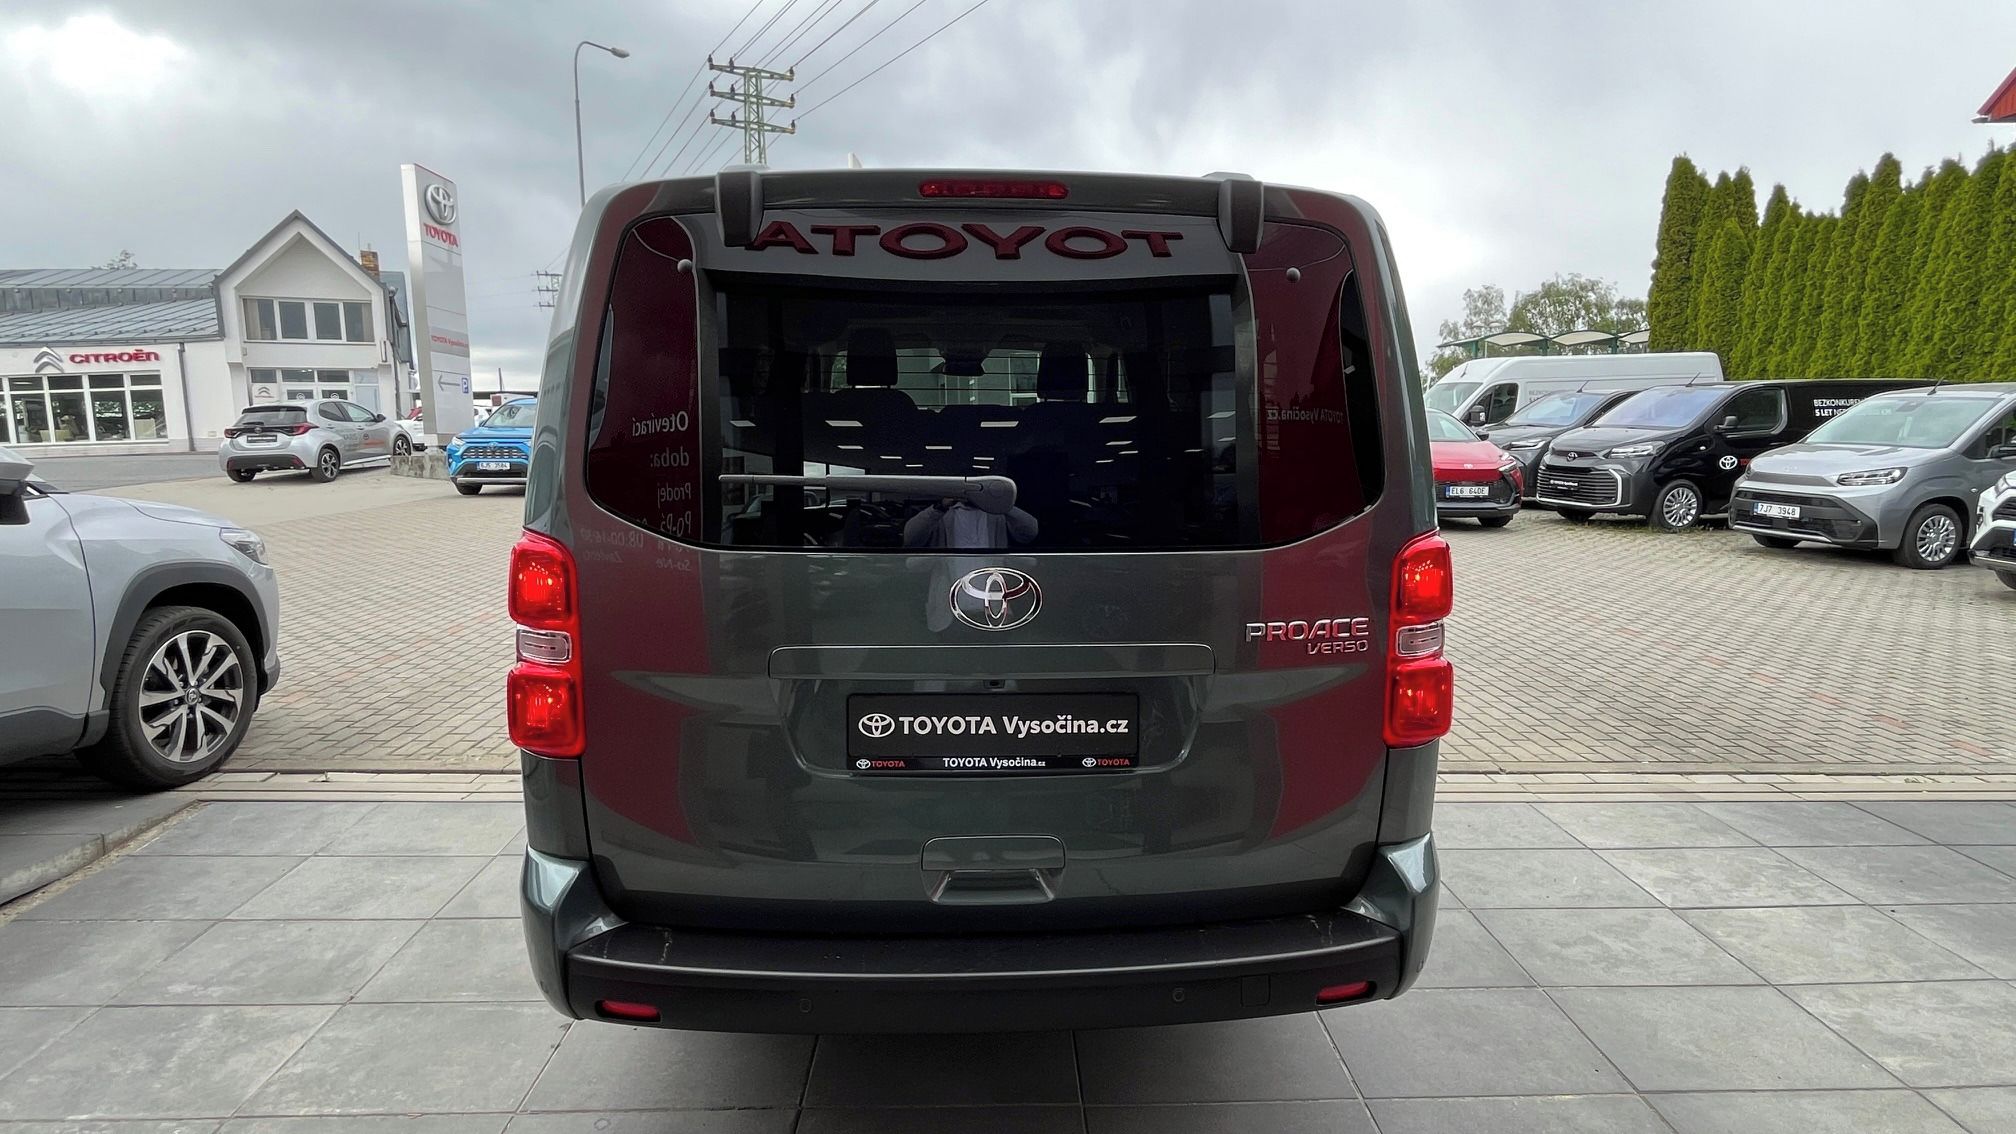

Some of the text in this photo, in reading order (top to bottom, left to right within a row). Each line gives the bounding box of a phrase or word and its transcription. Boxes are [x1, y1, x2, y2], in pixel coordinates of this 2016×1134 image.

[423, 222, 459, 248] TOYOTA
[1821, 409, 1833, 417] LET
[1760, 504, 1773, 513] 7J7
[1245, 617, 1369, 642] PROACE
[1307, 640, 1369, 655] VERSO
[898, 714, 1129, 739] TOYOTA Vysočina.cz
[871, 760, 906, 768] TOYOTA
[942, 757, 1046, 769] TOYOTA Vysočina.cz
[1097, 758, 1131, 766] TOYOTA
